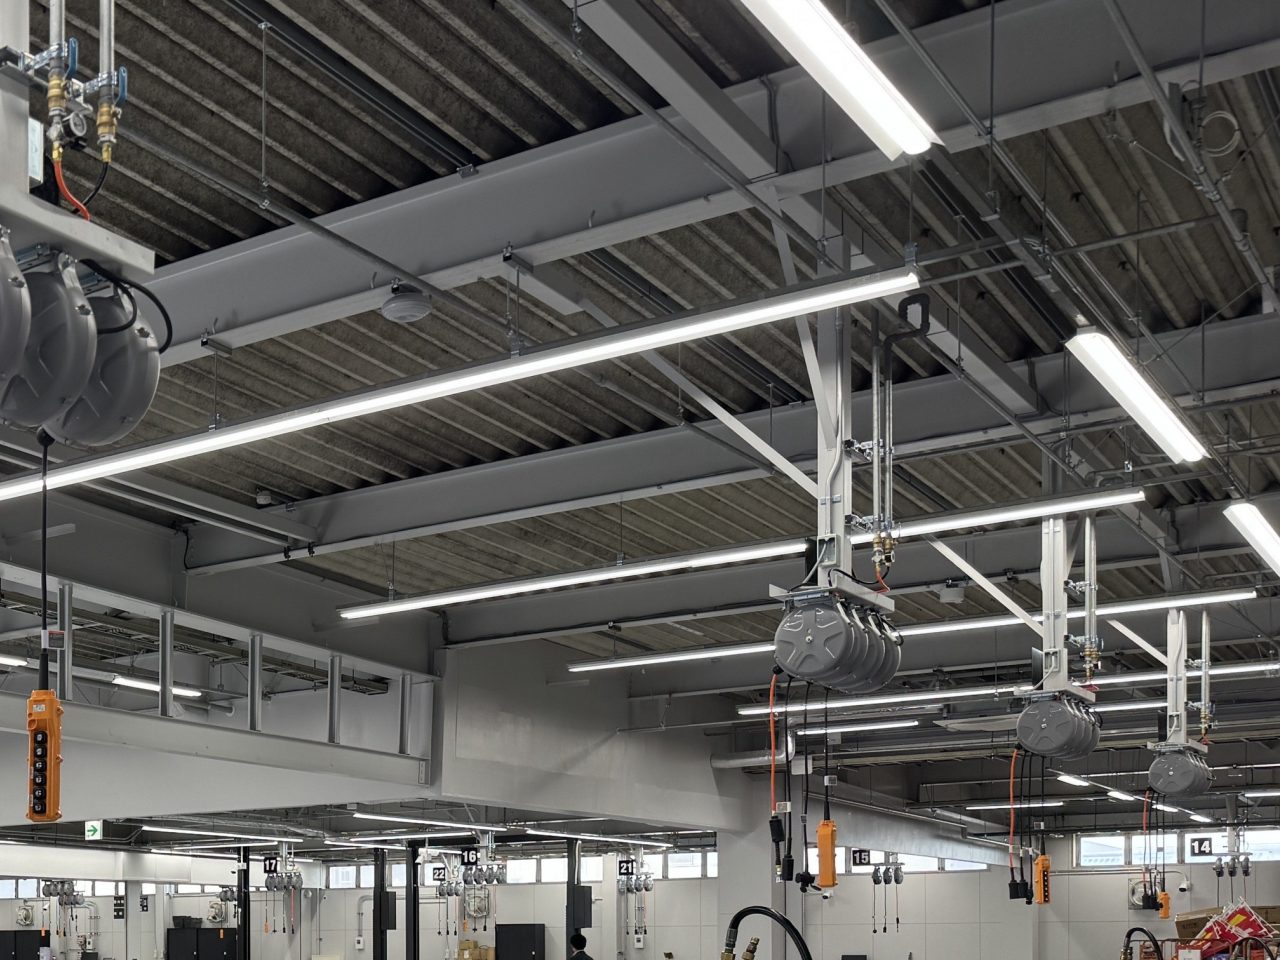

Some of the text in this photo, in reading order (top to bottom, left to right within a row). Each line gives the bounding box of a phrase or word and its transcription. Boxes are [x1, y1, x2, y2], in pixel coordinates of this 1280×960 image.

[1191, 840, 1211, 854] 14
[462, 850, 477, 863] 16
[853, 852, 869, 864] 15
[264, 859, 276, 871] 17
[620, 862, 632, 873] 21
[433, 869, 445, 879] 22
